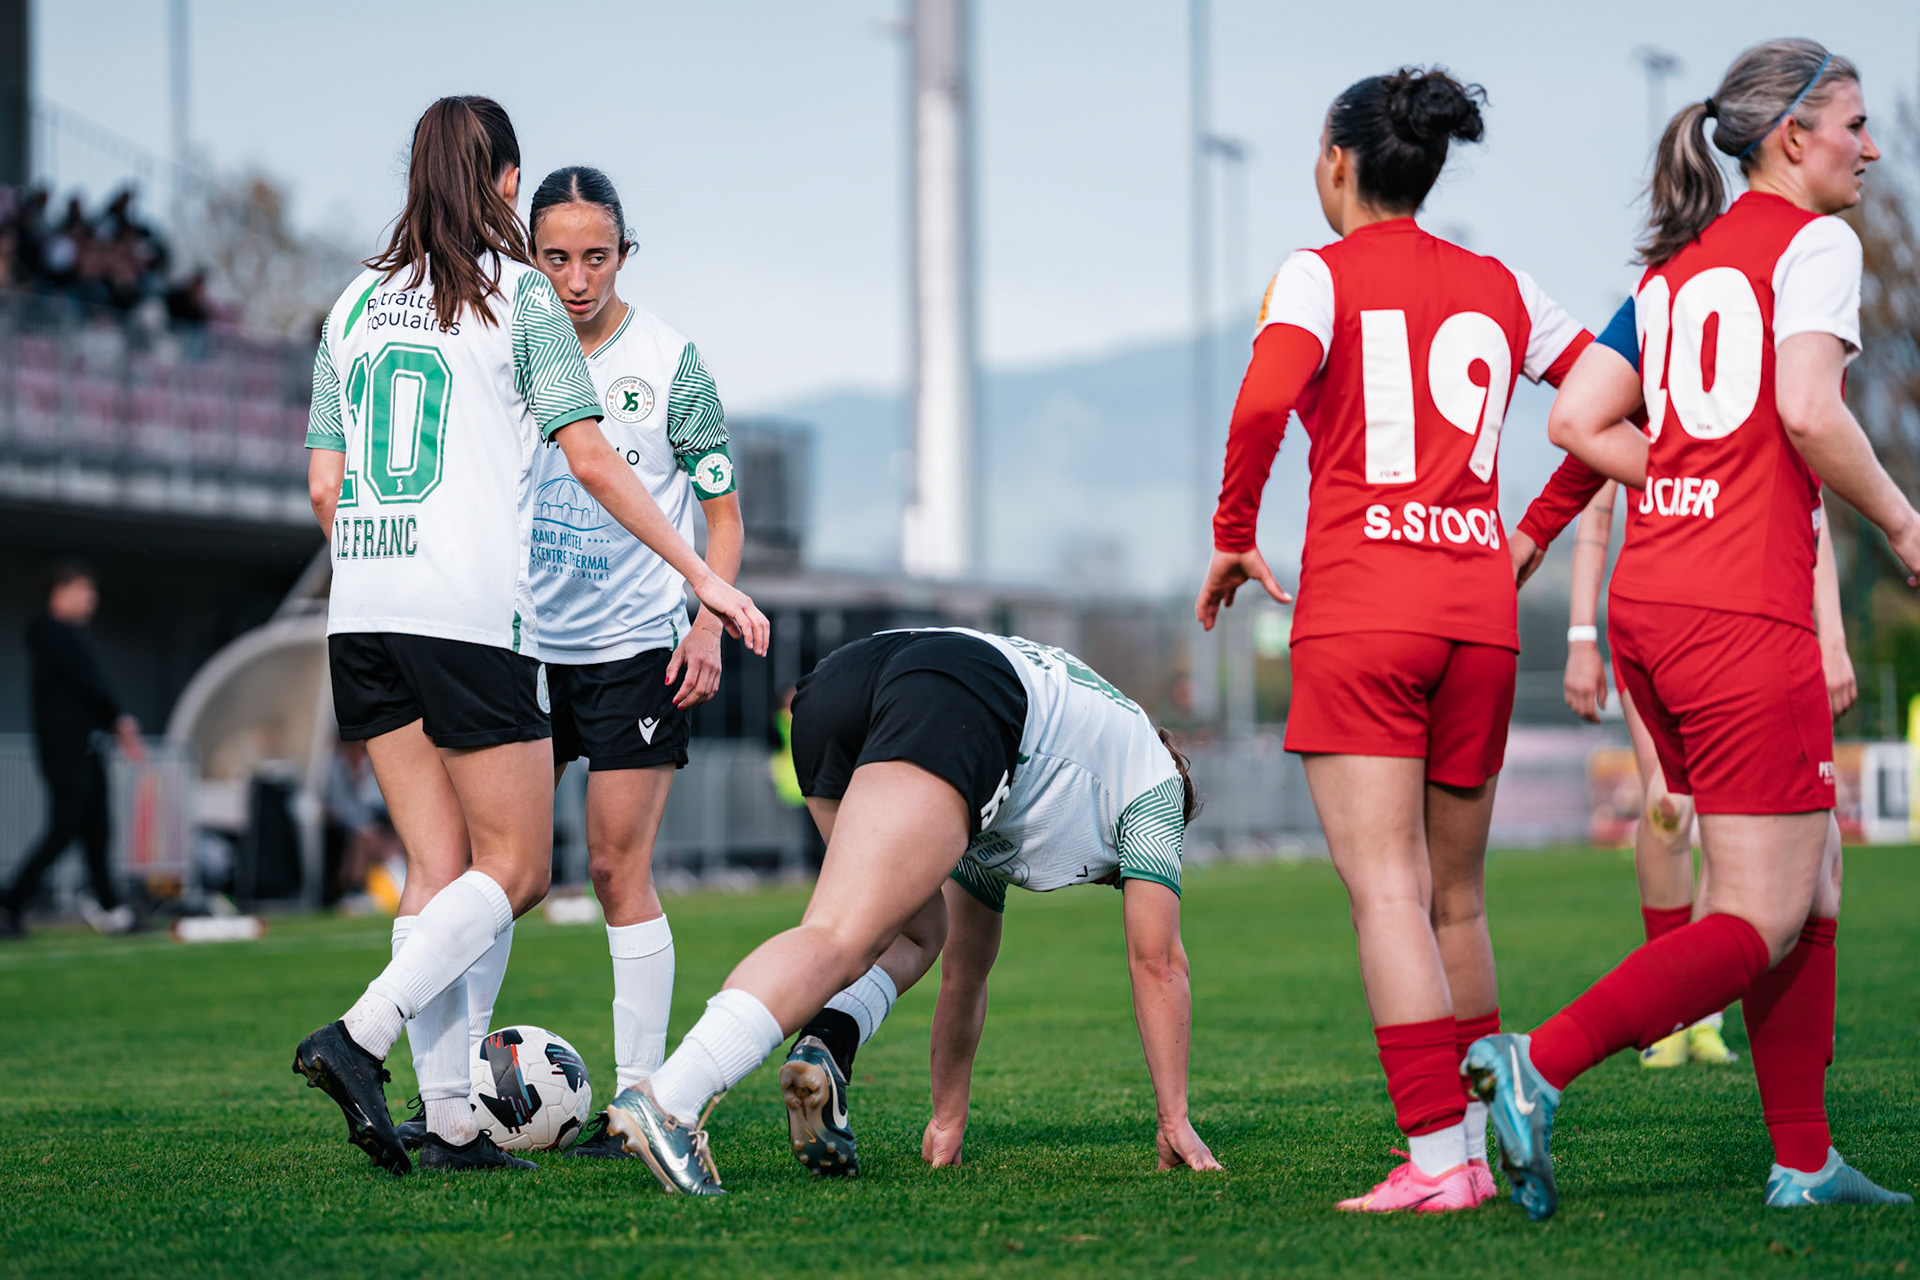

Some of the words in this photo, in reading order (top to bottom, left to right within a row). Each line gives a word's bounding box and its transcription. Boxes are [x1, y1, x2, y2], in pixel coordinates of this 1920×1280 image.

[367, 290, 437, 315] Rtraite
[611, 379, 637, 393] YVERDON
[1360, 309, 1512, 485] 19
[532, 528, 557, 546] RAND
[537, 546, 567, 565] CENTRE
[569, 551, 610, 570] THERMAL
